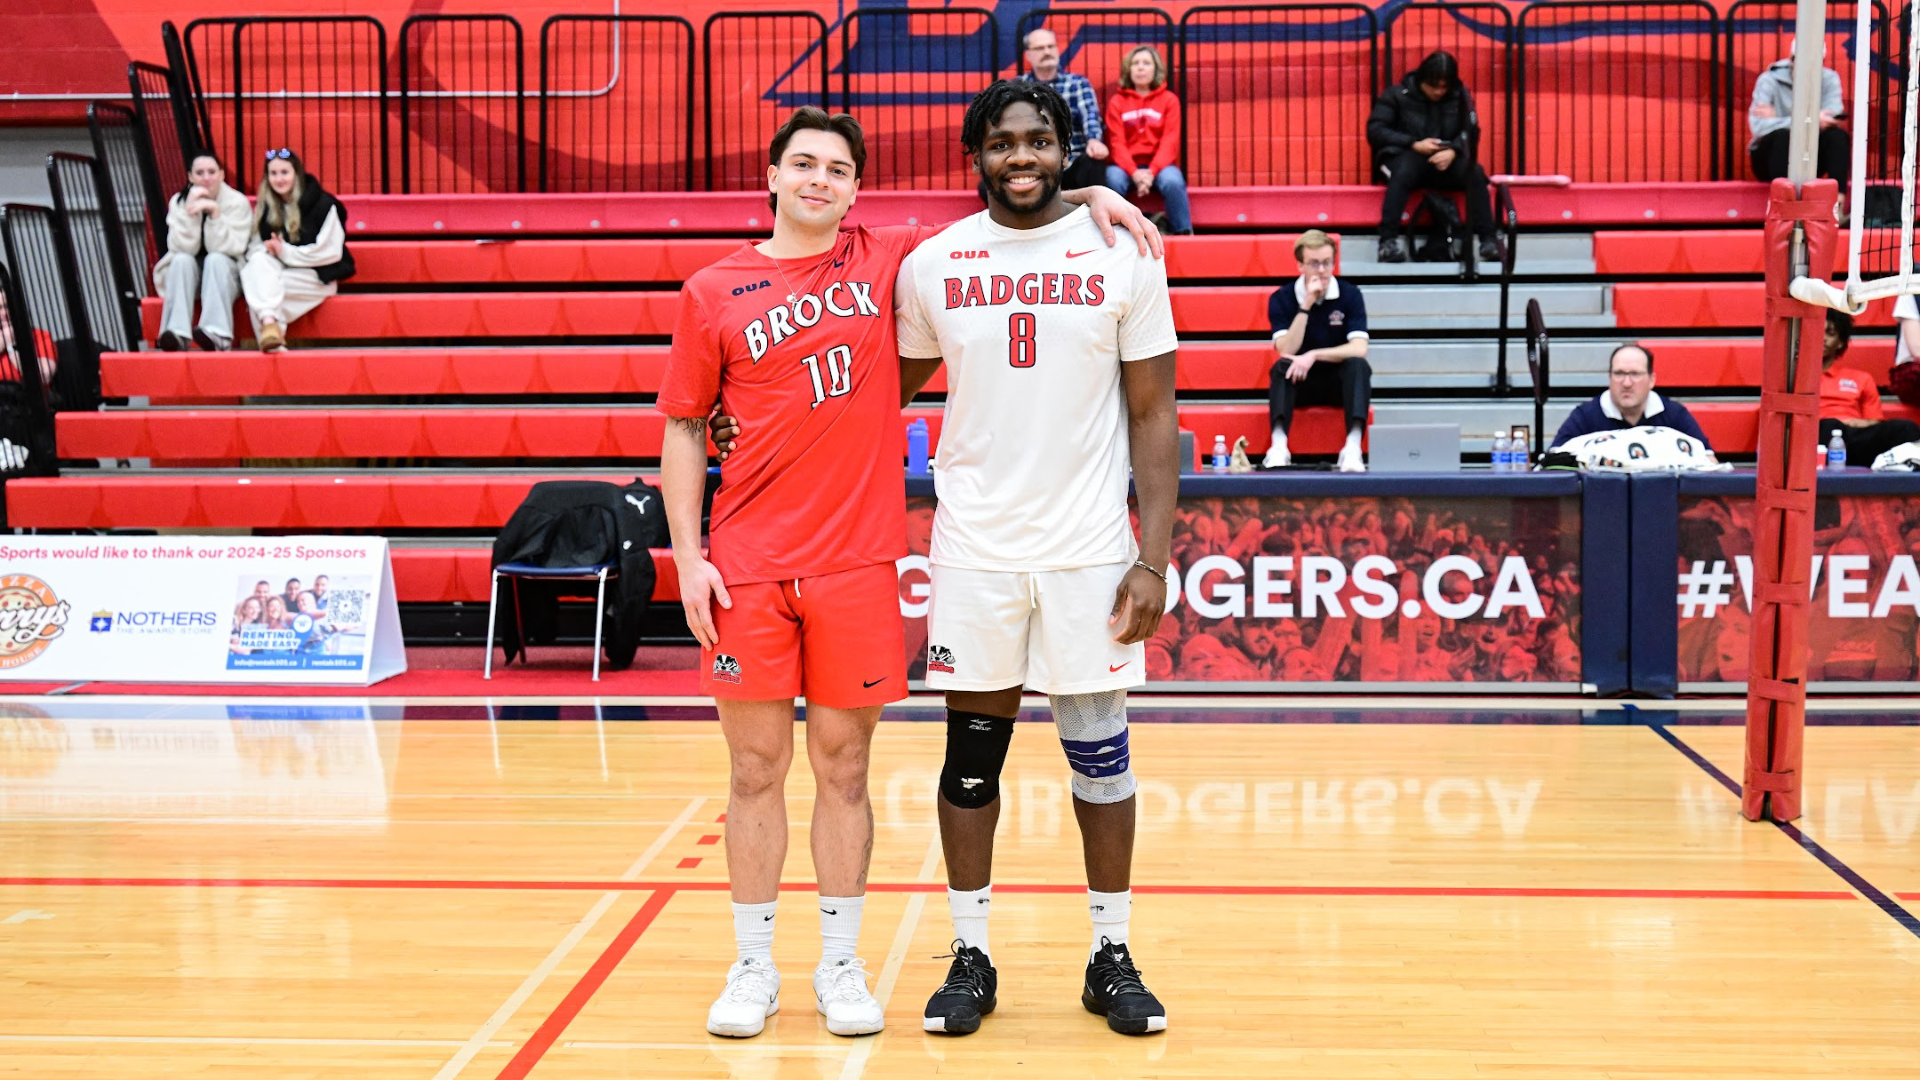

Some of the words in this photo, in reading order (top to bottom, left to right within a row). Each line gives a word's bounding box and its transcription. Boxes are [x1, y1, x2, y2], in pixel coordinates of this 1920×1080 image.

[950, 250, 990, 260] OUA
[731, 280, 772, 296] OUA
[944, 273, 1105, 310] BADGERS
[743, 281, 881, 365] BROCK
[1008, 312, 1036, 368] 8
[801, 344, 852, 410] 10
[0, 546, 48, 561] Sports
[52, 546, 99, 559] would
[103, 547, 129, 559] like
[133, 547, 148, 559] to
[152, 546, 194, 559] thank
[198, 549, 224, 559] our
[227, 547, 291, 559] 2024-25
[295, 546, 366, 561] Sponsors
[896, 555, 1546, 619] GGERS.CA
[117, 612, 217, 626] NOTHERS
[242, 631, 294, 639] RENTING
[241, 640, 269, 648] MADE
[271, 640, 300, 648] EASY
